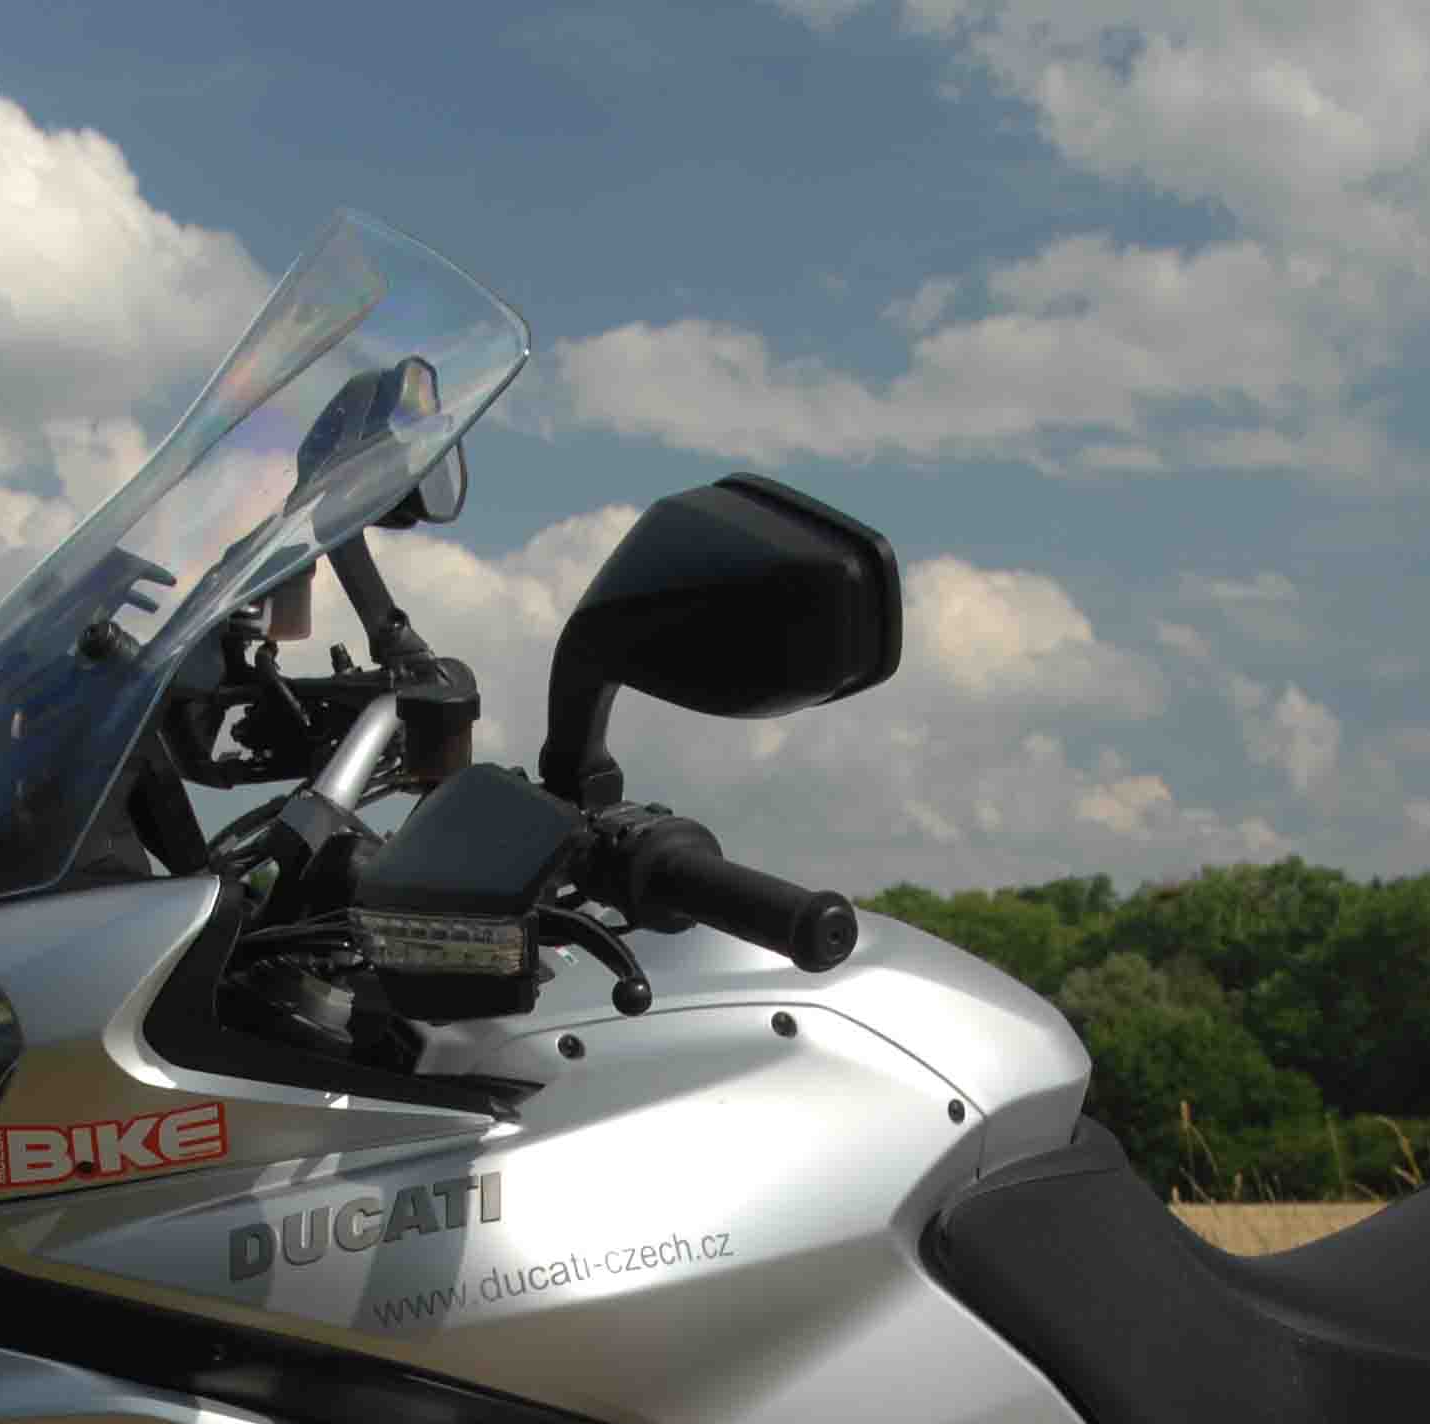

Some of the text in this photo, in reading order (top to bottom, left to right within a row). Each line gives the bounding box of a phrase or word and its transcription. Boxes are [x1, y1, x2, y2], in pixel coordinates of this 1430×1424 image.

[6, 1103, 223, 1184] BIKE
[229, 1171, 502, 1281] DUCATI
[372, 1231, 735, 1329] www.ducati-czech.cz
